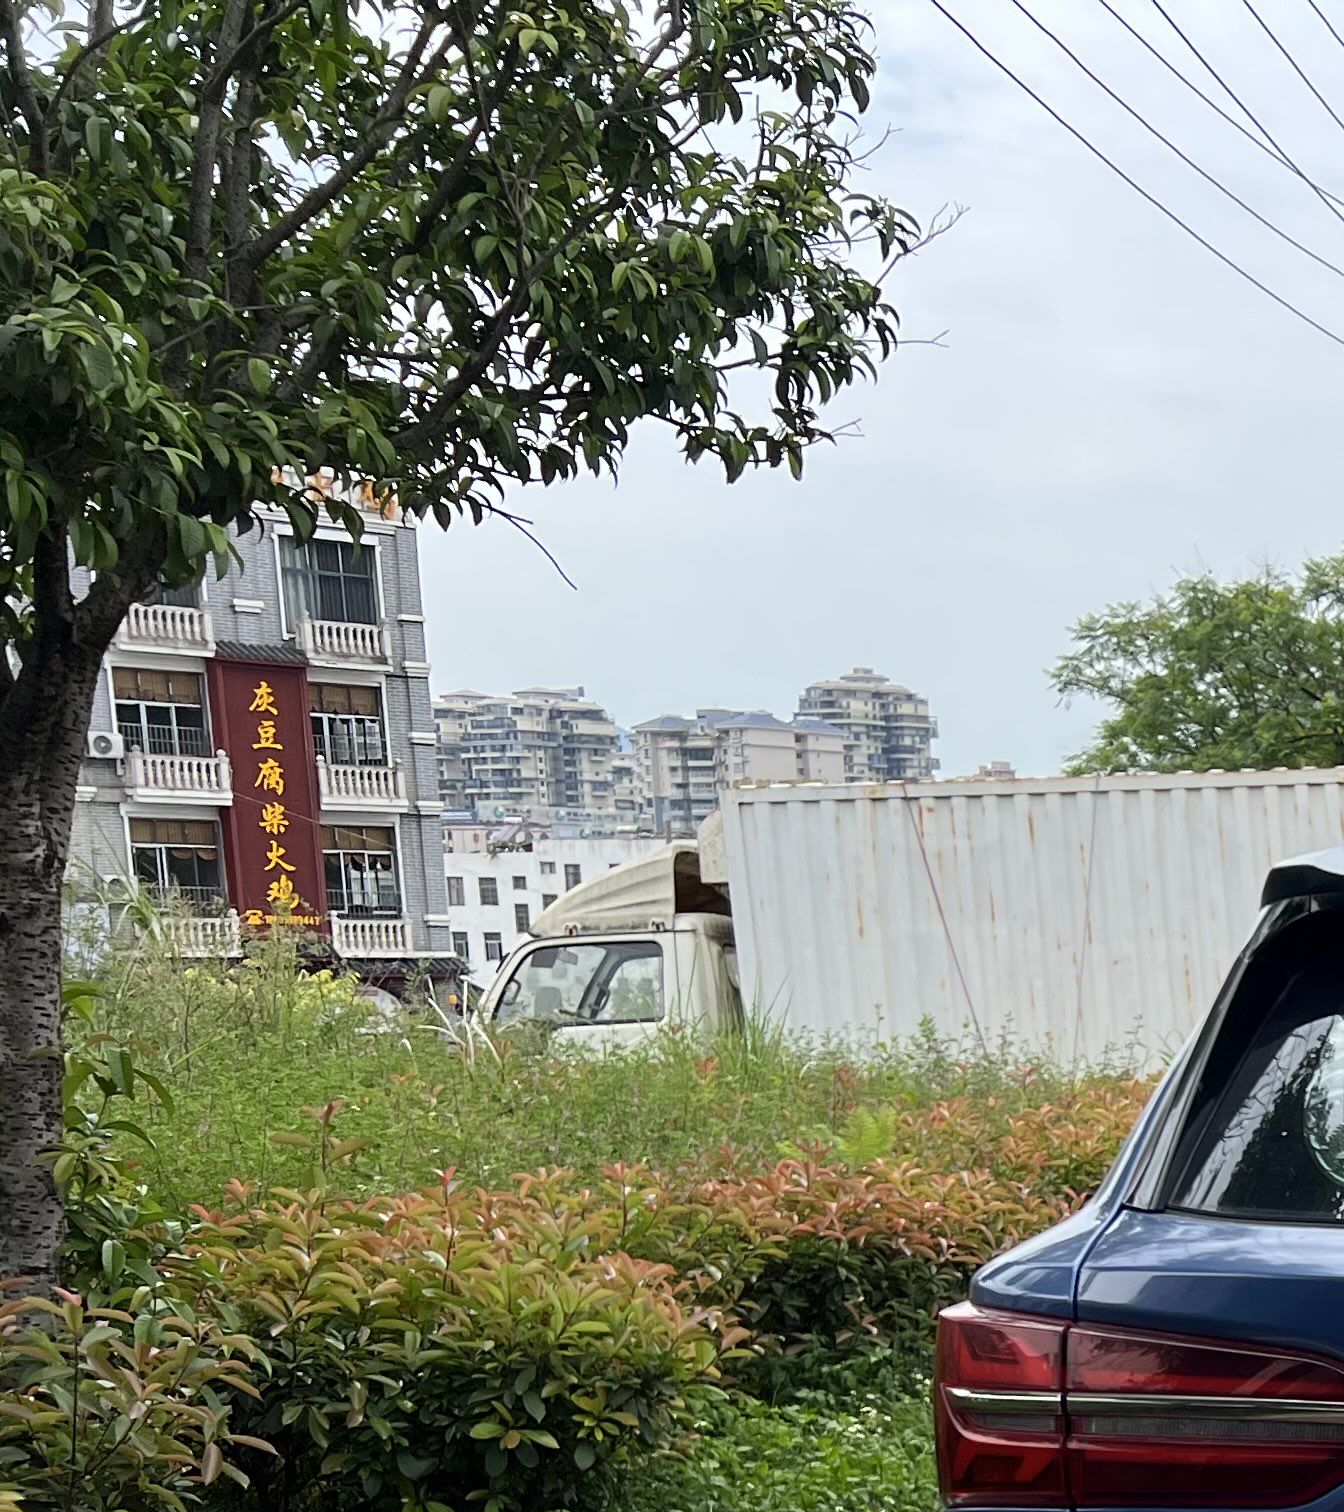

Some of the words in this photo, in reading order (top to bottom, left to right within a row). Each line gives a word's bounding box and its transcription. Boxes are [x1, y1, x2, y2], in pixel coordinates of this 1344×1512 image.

[248, 680, 299, 909] 灰豆腐柴火鸡
